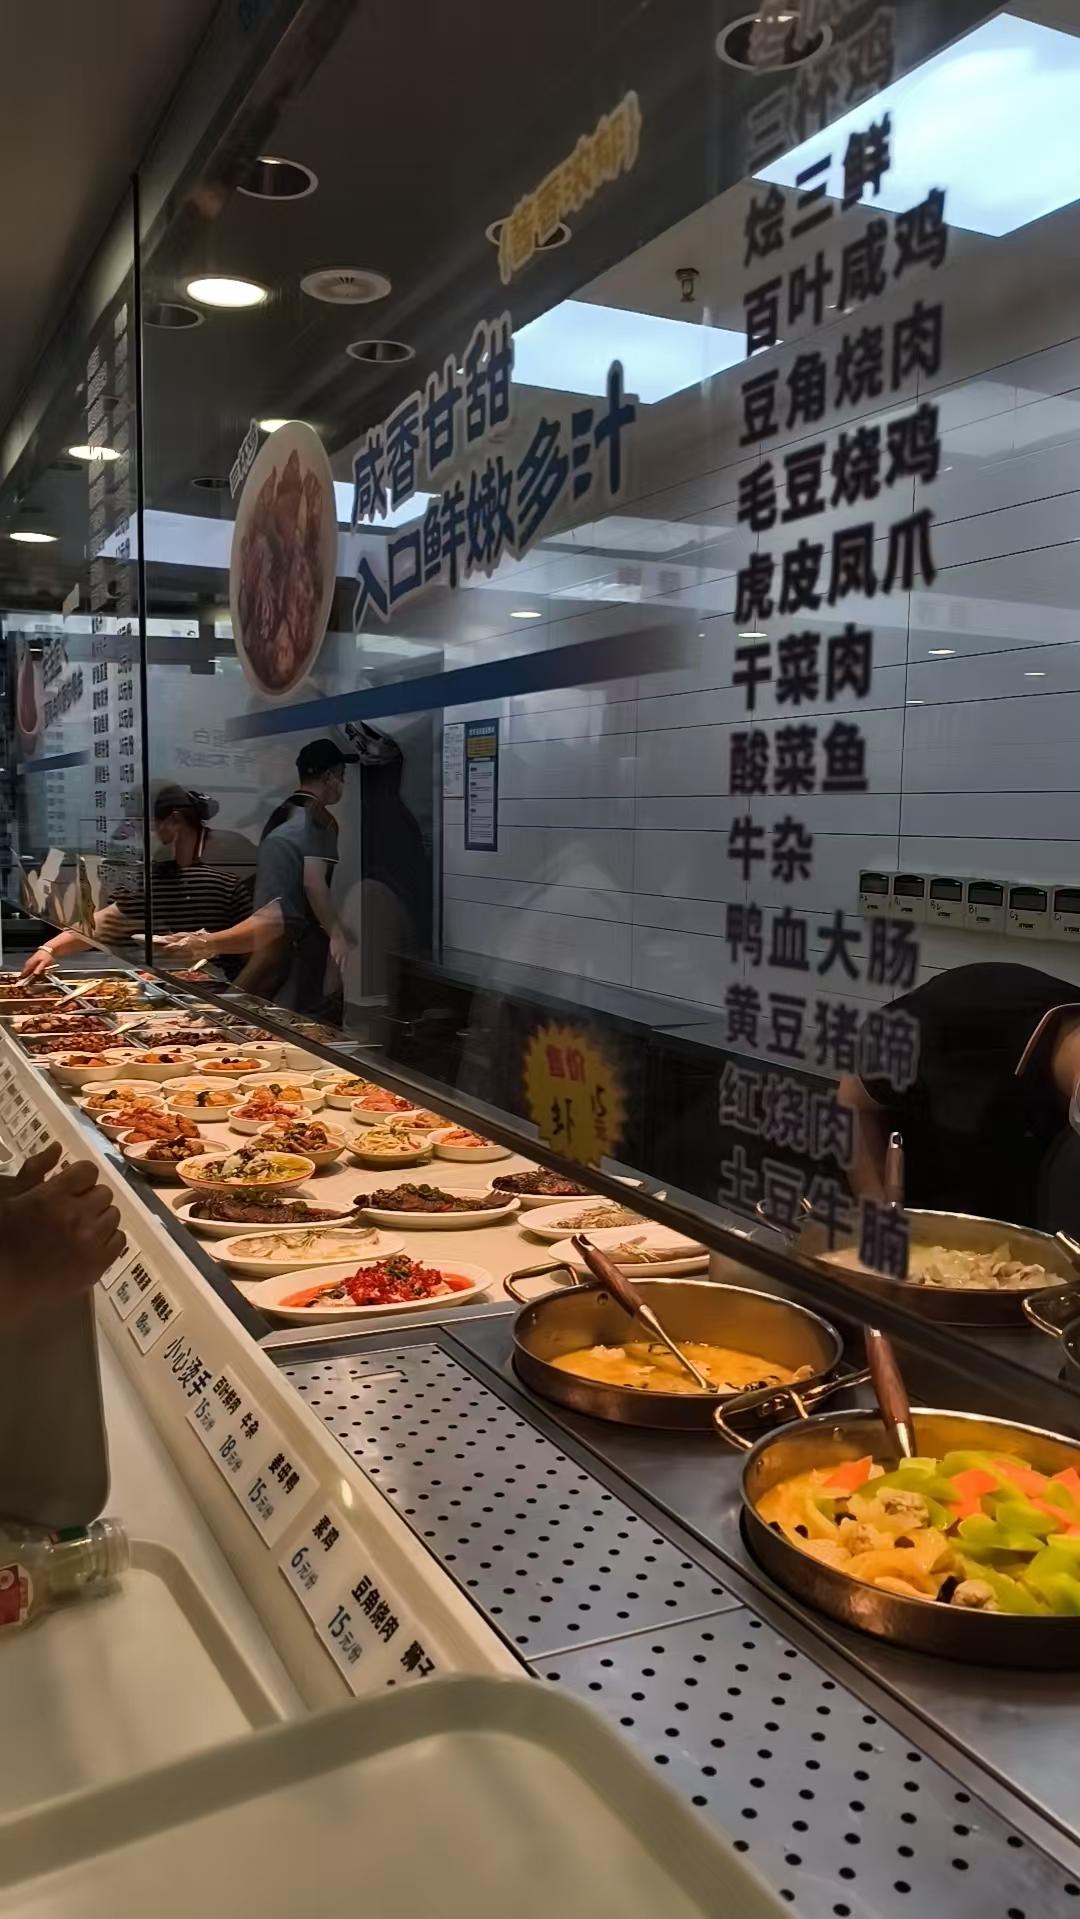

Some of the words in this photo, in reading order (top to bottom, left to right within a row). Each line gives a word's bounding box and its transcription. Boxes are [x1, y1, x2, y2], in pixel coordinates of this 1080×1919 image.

[743, 111, 892, 269] 烩三鲜
[743, 187, 949, 356] 百叶咸鸡
[351, 310, 515, 533] 咸香甘甜
[739, 301, 942, 447] 豆角烧肉
[352, 360, 640, 636] 入口鲜嫩多汁
[737, 402, 940, 532] 毛豆烧鸡
[734, 508, 938, 624] 虎皮凤爪
[732, 623, 873, 711] 干菜肉
[728, 720, 868, 796] 酸菜鱼
[727, 814, 814, 883] 牛杂
[724, 901, 921, 990] 鸭血大肠
[723, 982, 921, 1092] 黄豆猪蹄
[719, 1060, 856, 1169] 红烧肉
[718, 1145, 911, 1282] 土豆牛腩
[163, 1336, 212, 1397] 小心烫手
[240, 1411, 259, 1440] 牛杂
[311, 1514, 340, 1552] 素鸡
[352, 1575, 399, 1643] 豆角烧肉
